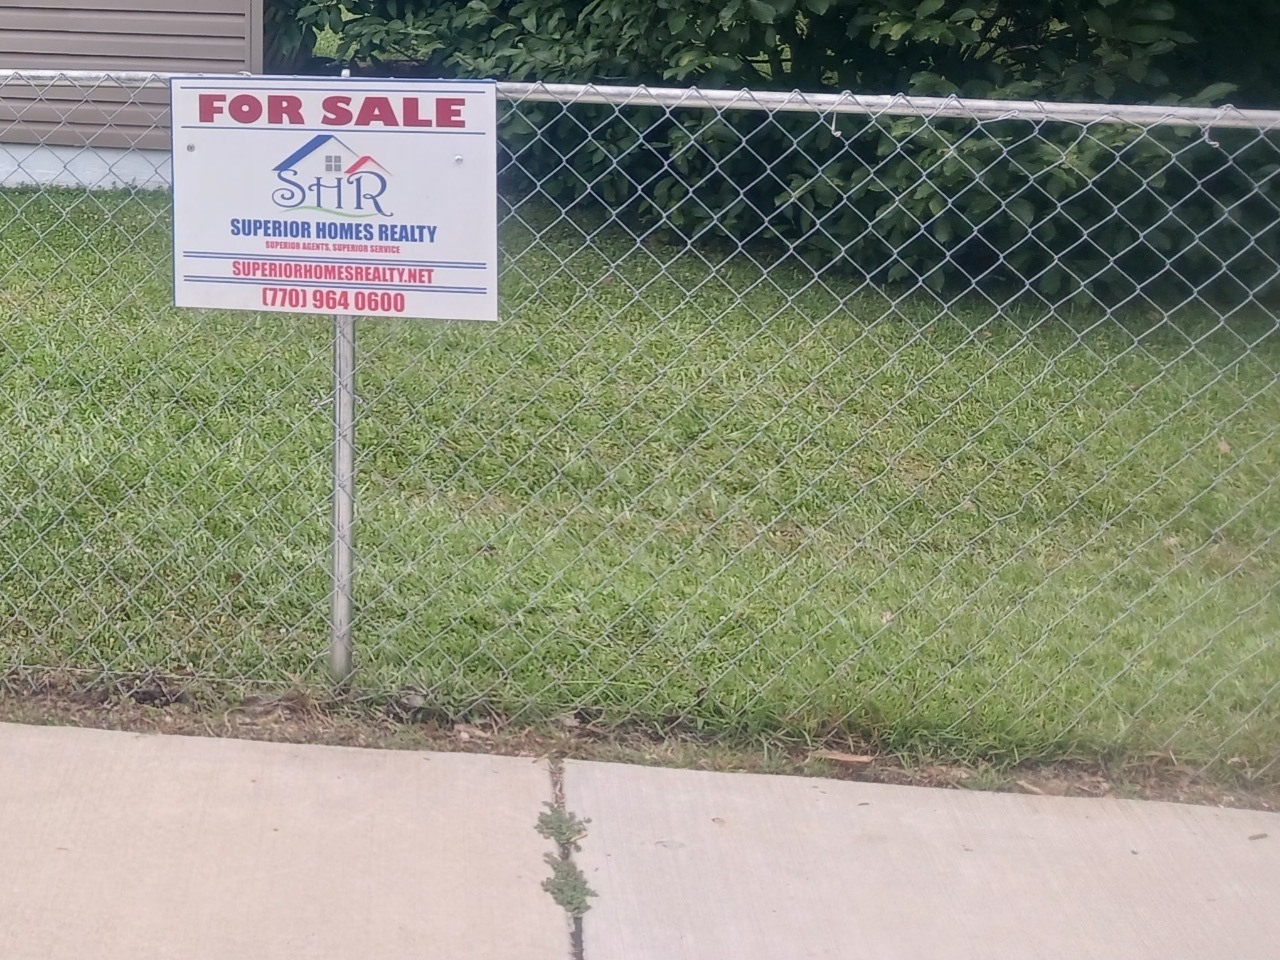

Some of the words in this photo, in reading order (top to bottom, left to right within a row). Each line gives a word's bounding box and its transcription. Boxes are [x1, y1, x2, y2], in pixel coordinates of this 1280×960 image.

[198, 94, 305, 124] FOR
[321, 96, 466, 128] SALE
[271, 169, 393, 217] SHR
[230, 219, 311, 238] SUPERIOR
[316, 222, 374, 240] HOMES
[378, 224, 437, 242] REALTY
[265, 241, 300, 250] SUPERIOR
[302, 242, 332, 252] AGENTS,
[333, 244, 368, 253] SUPERIOR
[370, 245, 400, 254] SERVICE
[232, 261, 434, 284] SUPERIORHOMESREALTY.NET
[262, 288, 307, 308] (770)
[312, 290, 349, 310] 964
[354, 292, 405, 312] 0600
